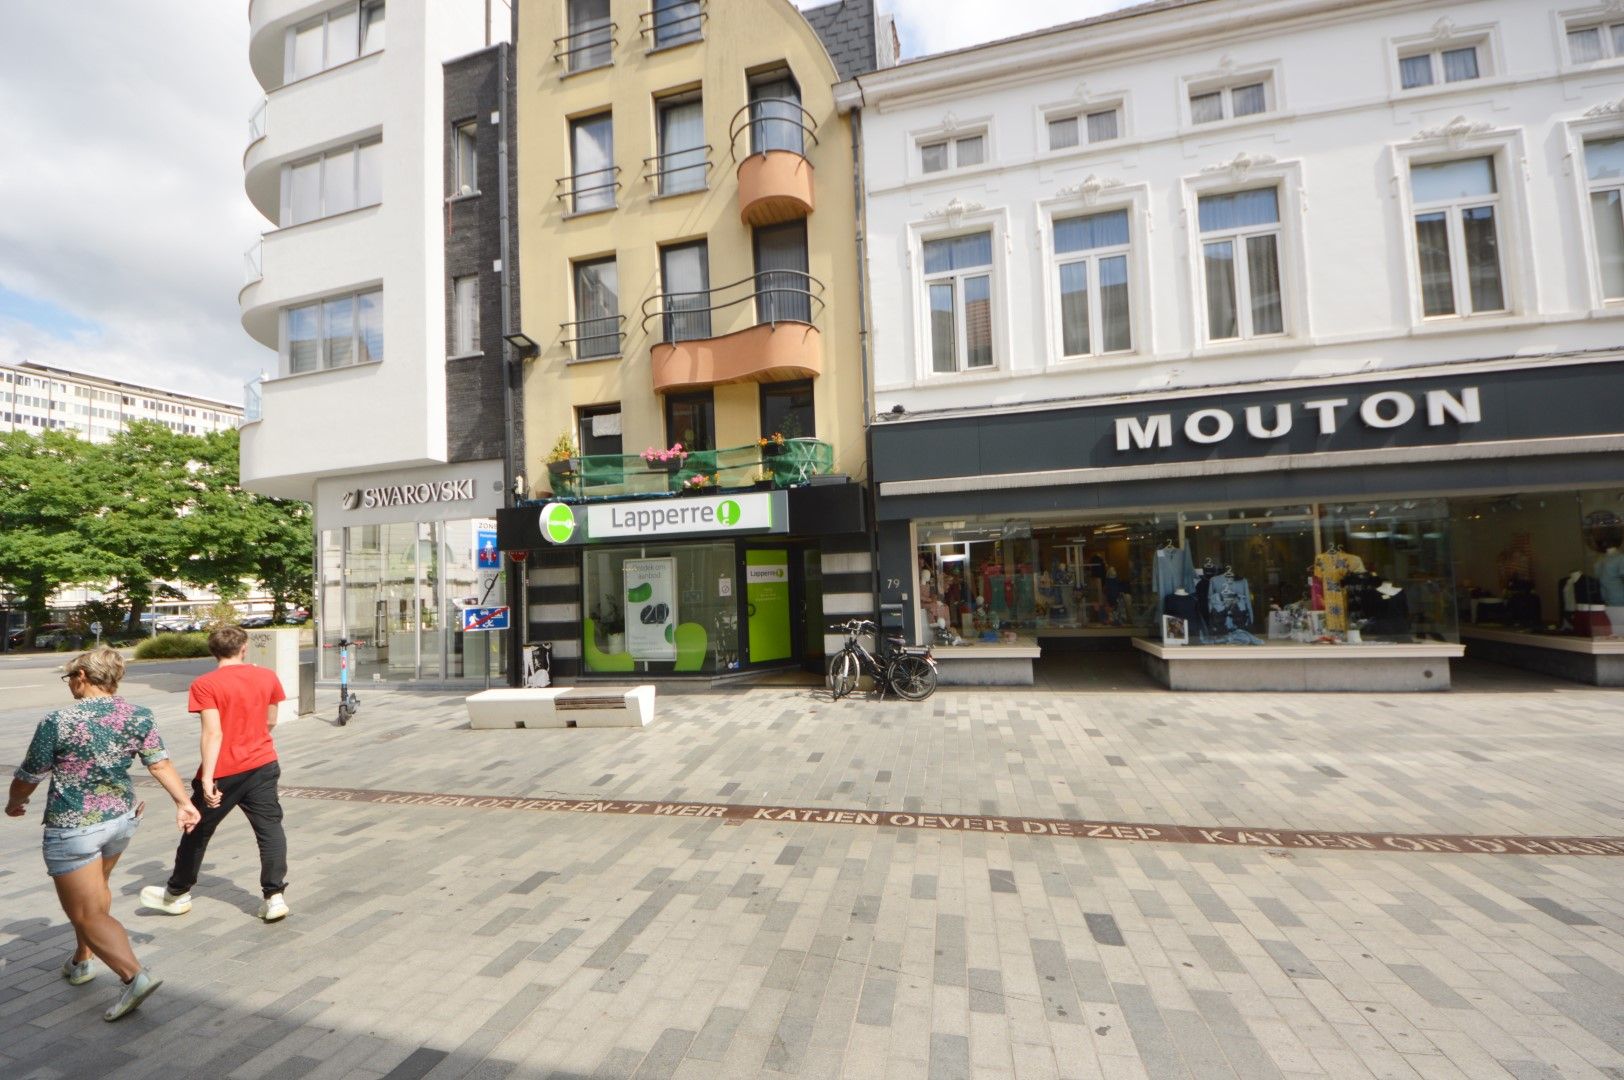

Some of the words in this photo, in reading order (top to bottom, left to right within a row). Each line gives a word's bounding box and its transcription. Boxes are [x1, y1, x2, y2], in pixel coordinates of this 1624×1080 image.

[1115, 387, 1481, 451] MOUTON
[364, 478, 475, 509] SWAROVSKI
[611, 505, 714, 532] Lapperre
[750, 568, 777, 579] Lapperre
[887, 578, 900, 590] 79
[653, 804, 728, 817] WEIR
[752, 808, 879, 825] KATJEN
[889, 814, 1010, 832] OEVER
[1022, 820, 1074, 836] DE
[1083, 823, 1162, 840] ZEP
